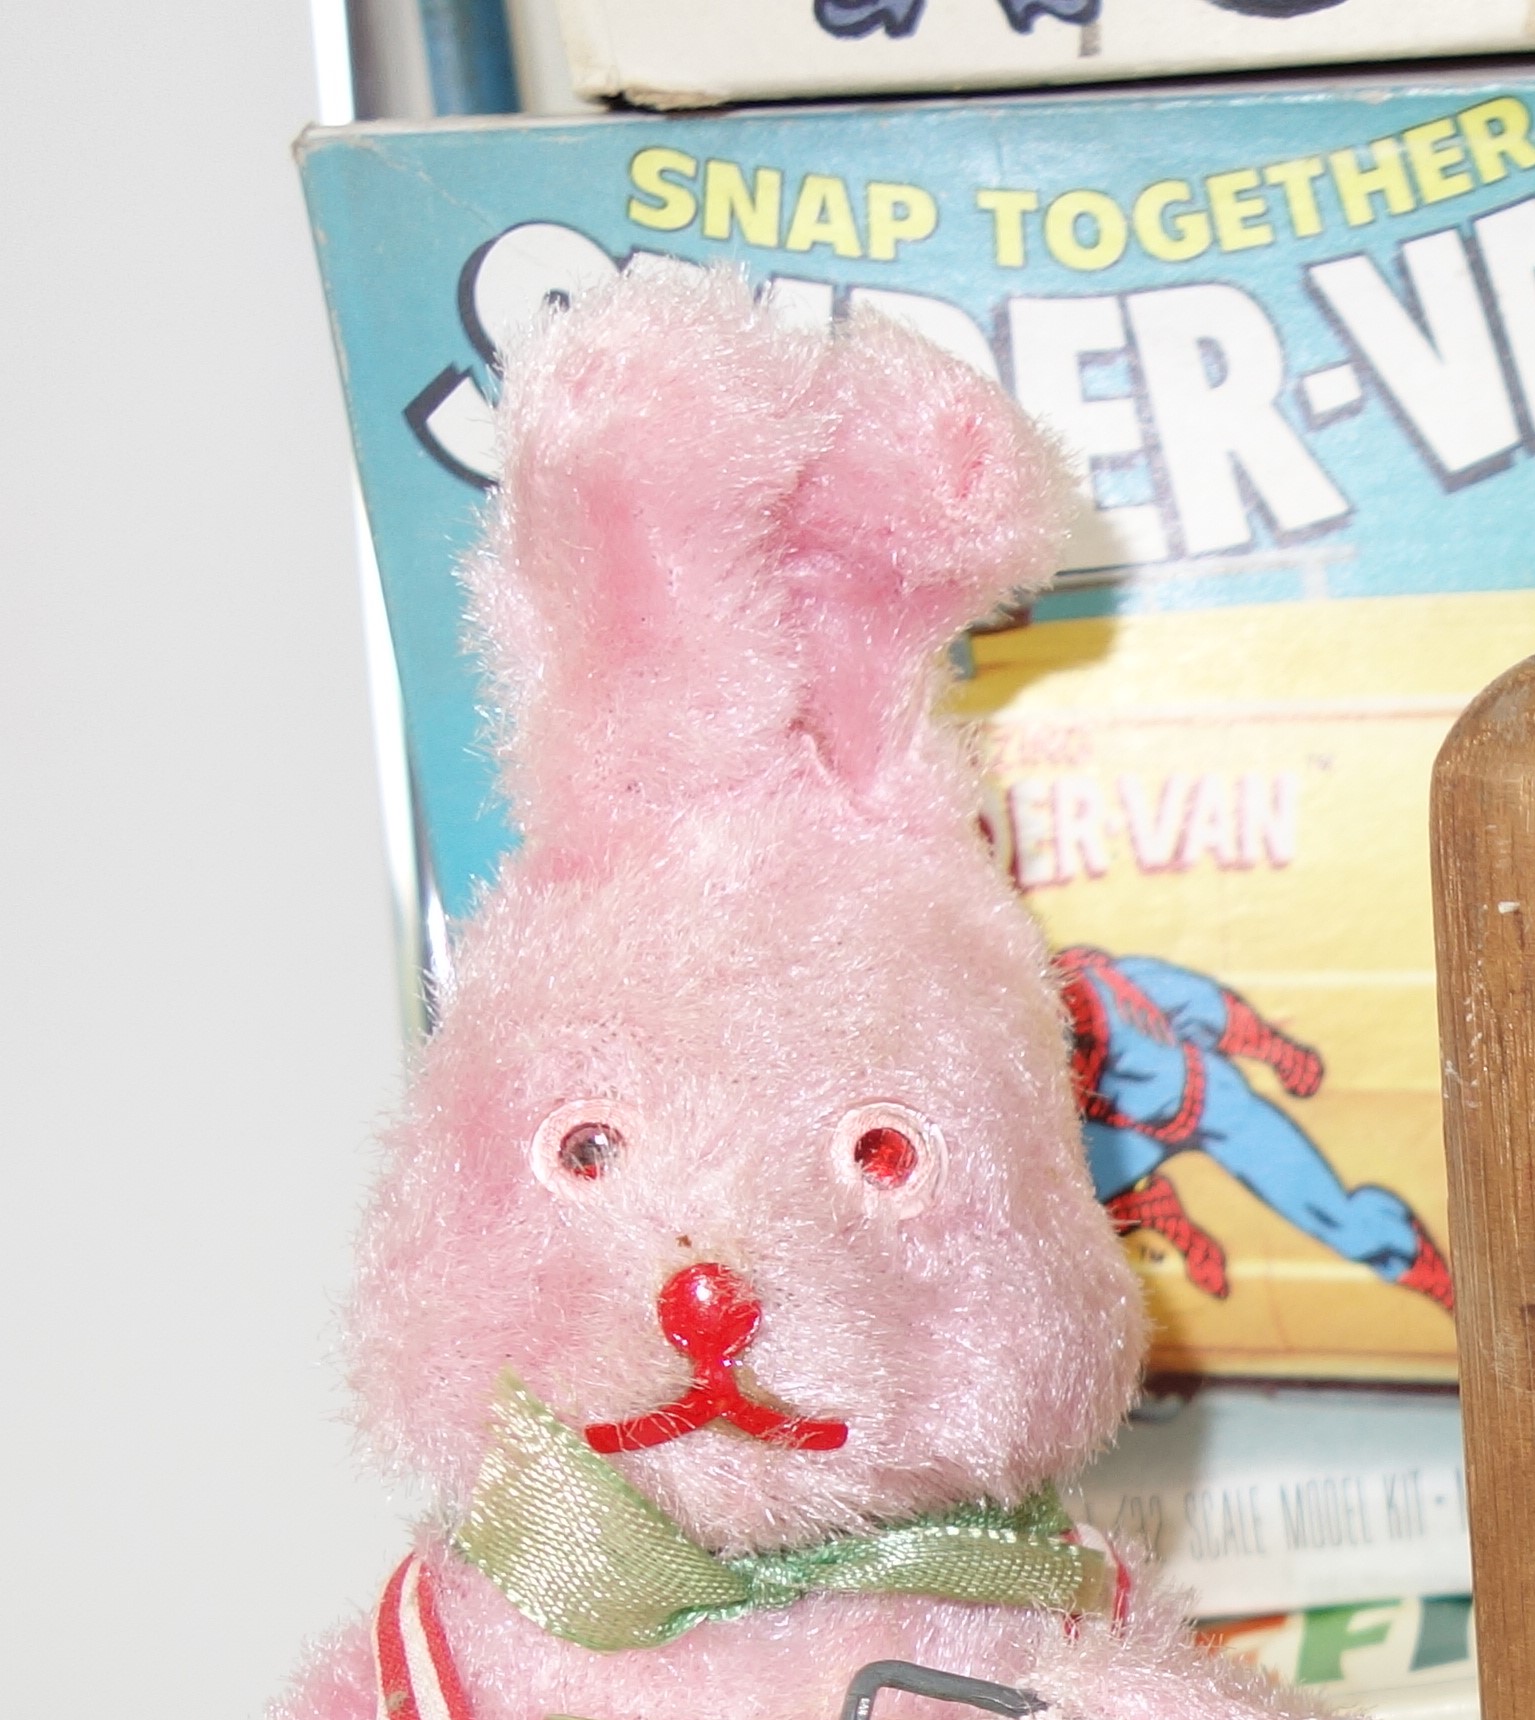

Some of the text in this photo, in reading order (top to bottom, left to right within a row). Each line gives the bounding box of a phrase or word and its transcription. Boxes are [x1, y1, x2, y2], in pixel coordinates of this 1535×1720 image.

[629, 146, 937, 261] SNAP
[1185, 1484, 1266, 1561] SCALE
[1278, 1472, 1373, 1553] MODEL
[1380, 1467, 1425, 1539] KIT
